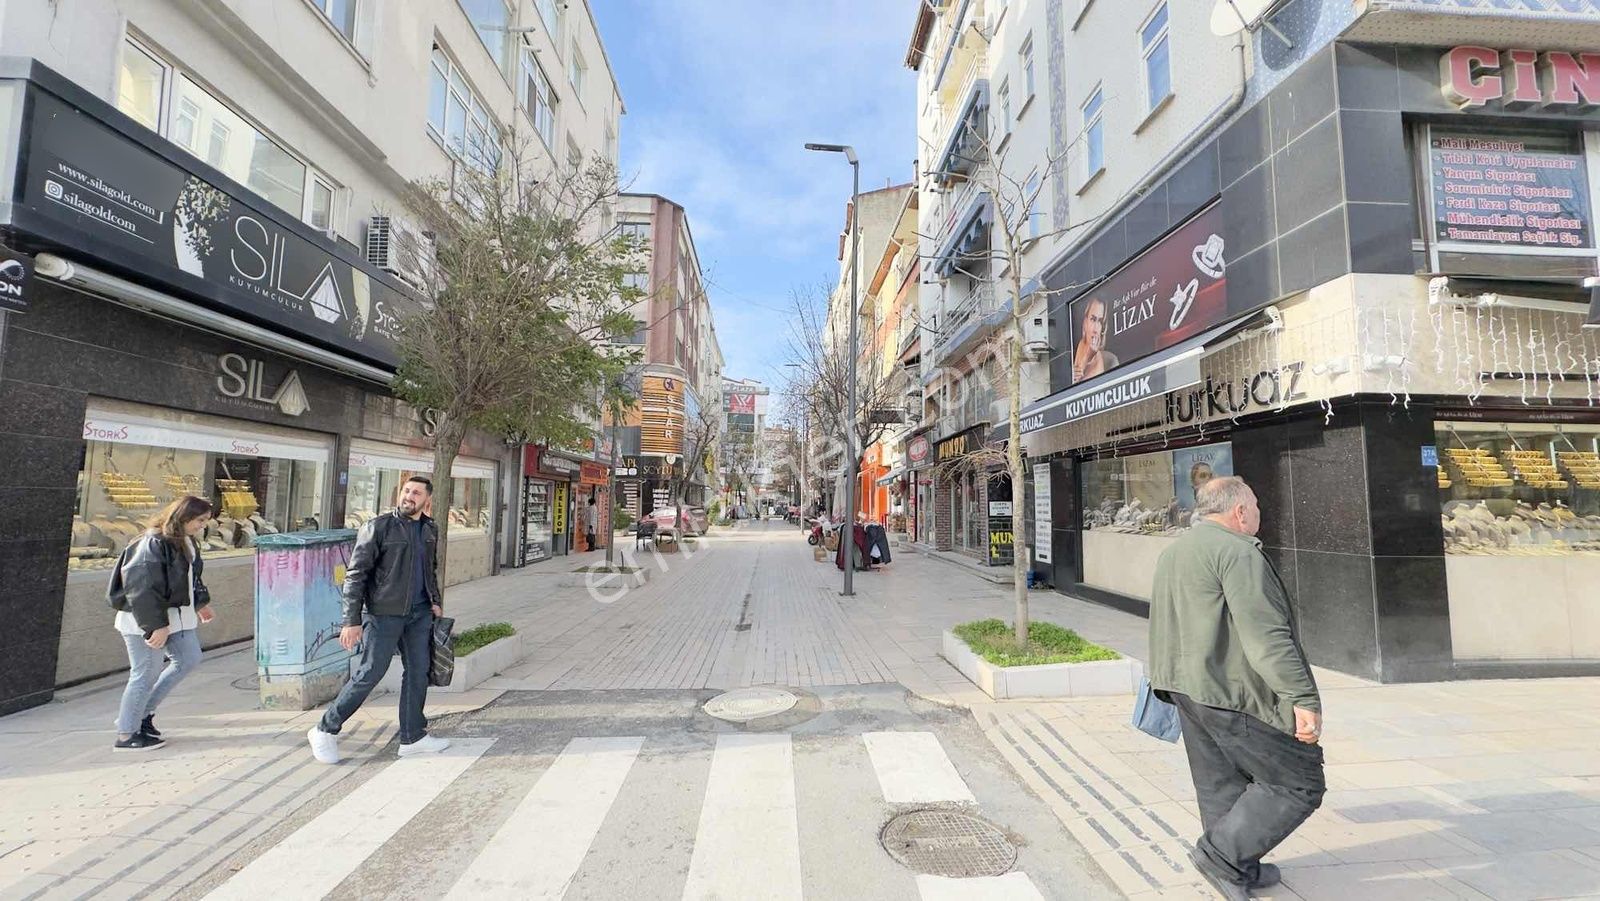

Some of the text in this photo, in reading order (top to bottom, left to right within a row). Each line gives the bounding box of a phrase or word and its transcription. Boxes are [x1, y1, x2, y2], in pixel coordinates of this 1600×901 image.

[58, 163, 155, 216] www.silagold.com
[63, 192, 136, 232] silagoldcom
[229, 275, 303, 311] KUYUMCULUK
[1066, 376, 1151, 419] KUYUMCULUK
